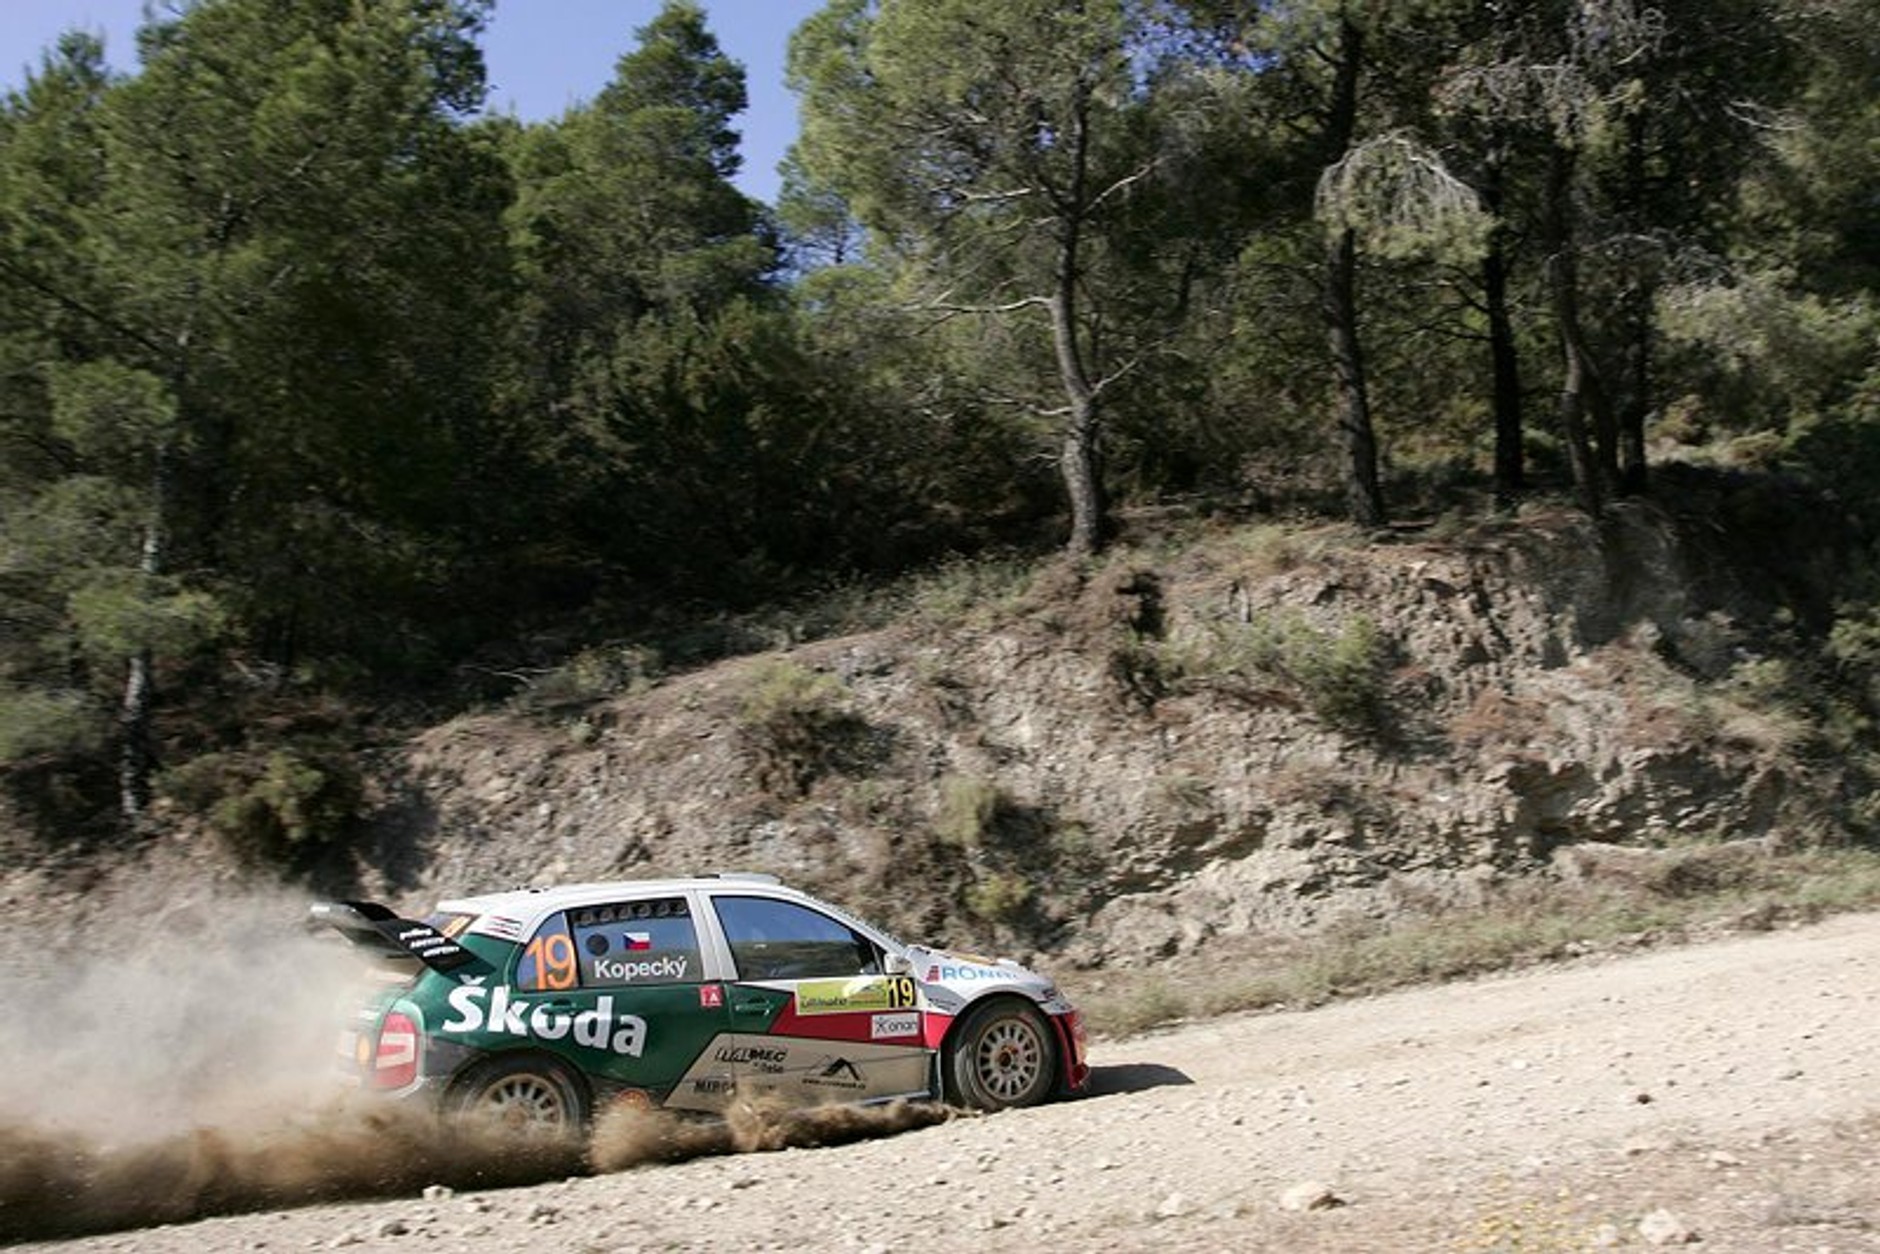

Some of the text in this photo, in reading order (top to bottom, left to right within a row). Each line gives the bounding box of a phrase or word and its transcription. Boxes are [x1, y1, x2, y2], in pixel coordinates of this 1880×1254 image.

[526, 933, 577, 990] 19
[594, 955, 688, 981] Kopecký
[886, 977, 914, 1007] 19
[441, 974, 648, 1058] Škoda
